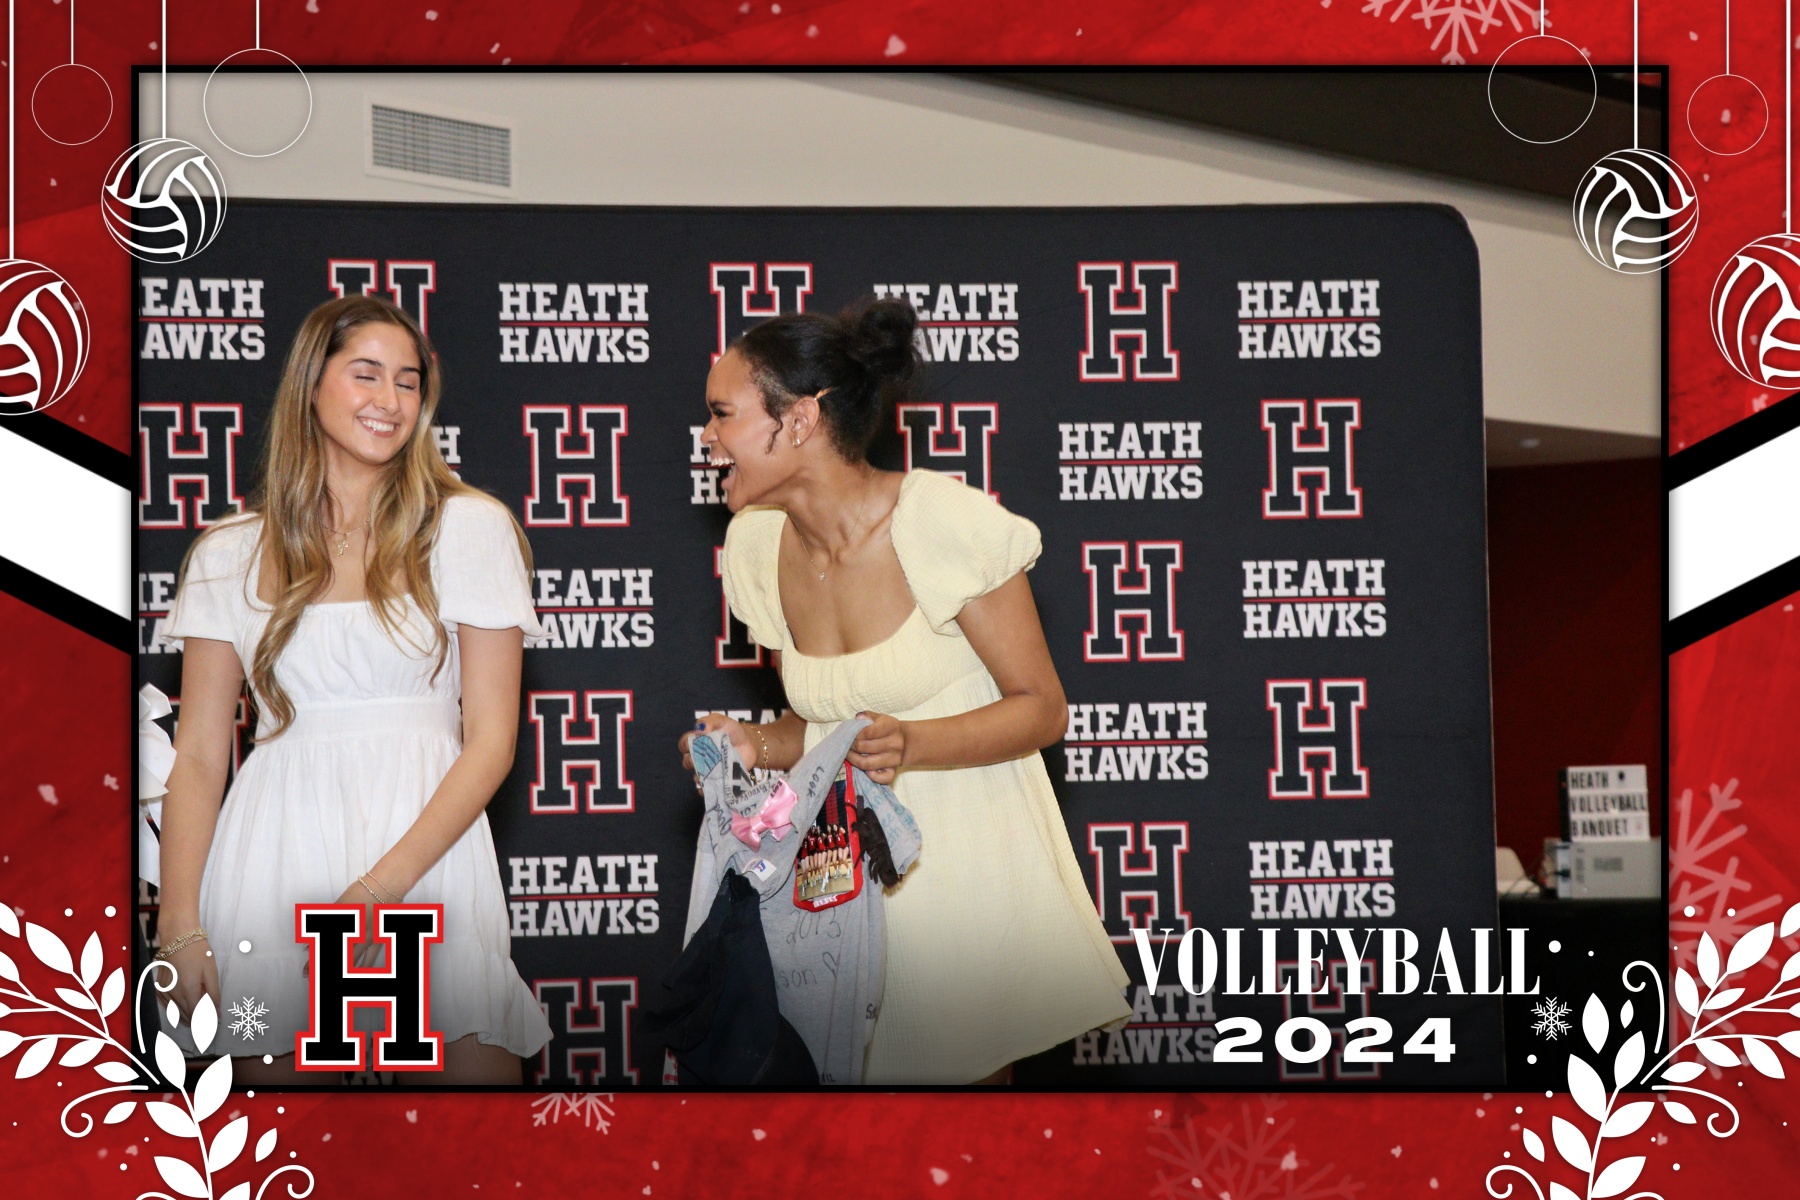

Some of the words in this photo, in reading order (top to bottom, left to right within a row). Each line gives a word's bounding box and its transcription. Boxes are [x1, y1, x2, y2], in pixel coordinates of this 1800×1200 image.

[140, 278, 265, 318] EATH
[499, 283, 649, 322] HEATH
[1237, 280, 1380, 318] HEATH
[1077, 261, 1180, 382] H
[1238, 323, 1381, 358] HAWKS
[140, 323, 266, 361] AWKS
[499, 327, 650, 363] HAWKS
[912, 327, 1020, 362] AWKS
[1058, 422, 1202, 460] HEATH
[1260, 398, 1363, 519] H
[139, 402, 246, 529] H
[523, 404, 631, 528] H
[1059, 465, 1203, 501] HAWKS
[533, 569, 654, 607] EATH
[1241, 560, 1386, 597] HEATH
[1082, 540, 1185, 662] H
[536, 612, 655, 648] AWKS
[1243, 603, 1387, 639] HAWKS
[1064, 702, 1208, 741] HEATH
[1266, 678, 1370, 800] H
[528, 690, 635, 814] H
[1064, 745, 1209, 782] HAWKS
[1570, 772, 1609, 789] HEATH
[1570, 792, 1646, 813] VOLLEYBALL
[509, 855, 659, 895] HEATH
[1249, 839, 1394, 878] HEATH
[509, 900, 660, 937] HAWKS
[1250, 883, 1396, 919] HAWKS
[1122, 984, 1217, 1022] ATH
